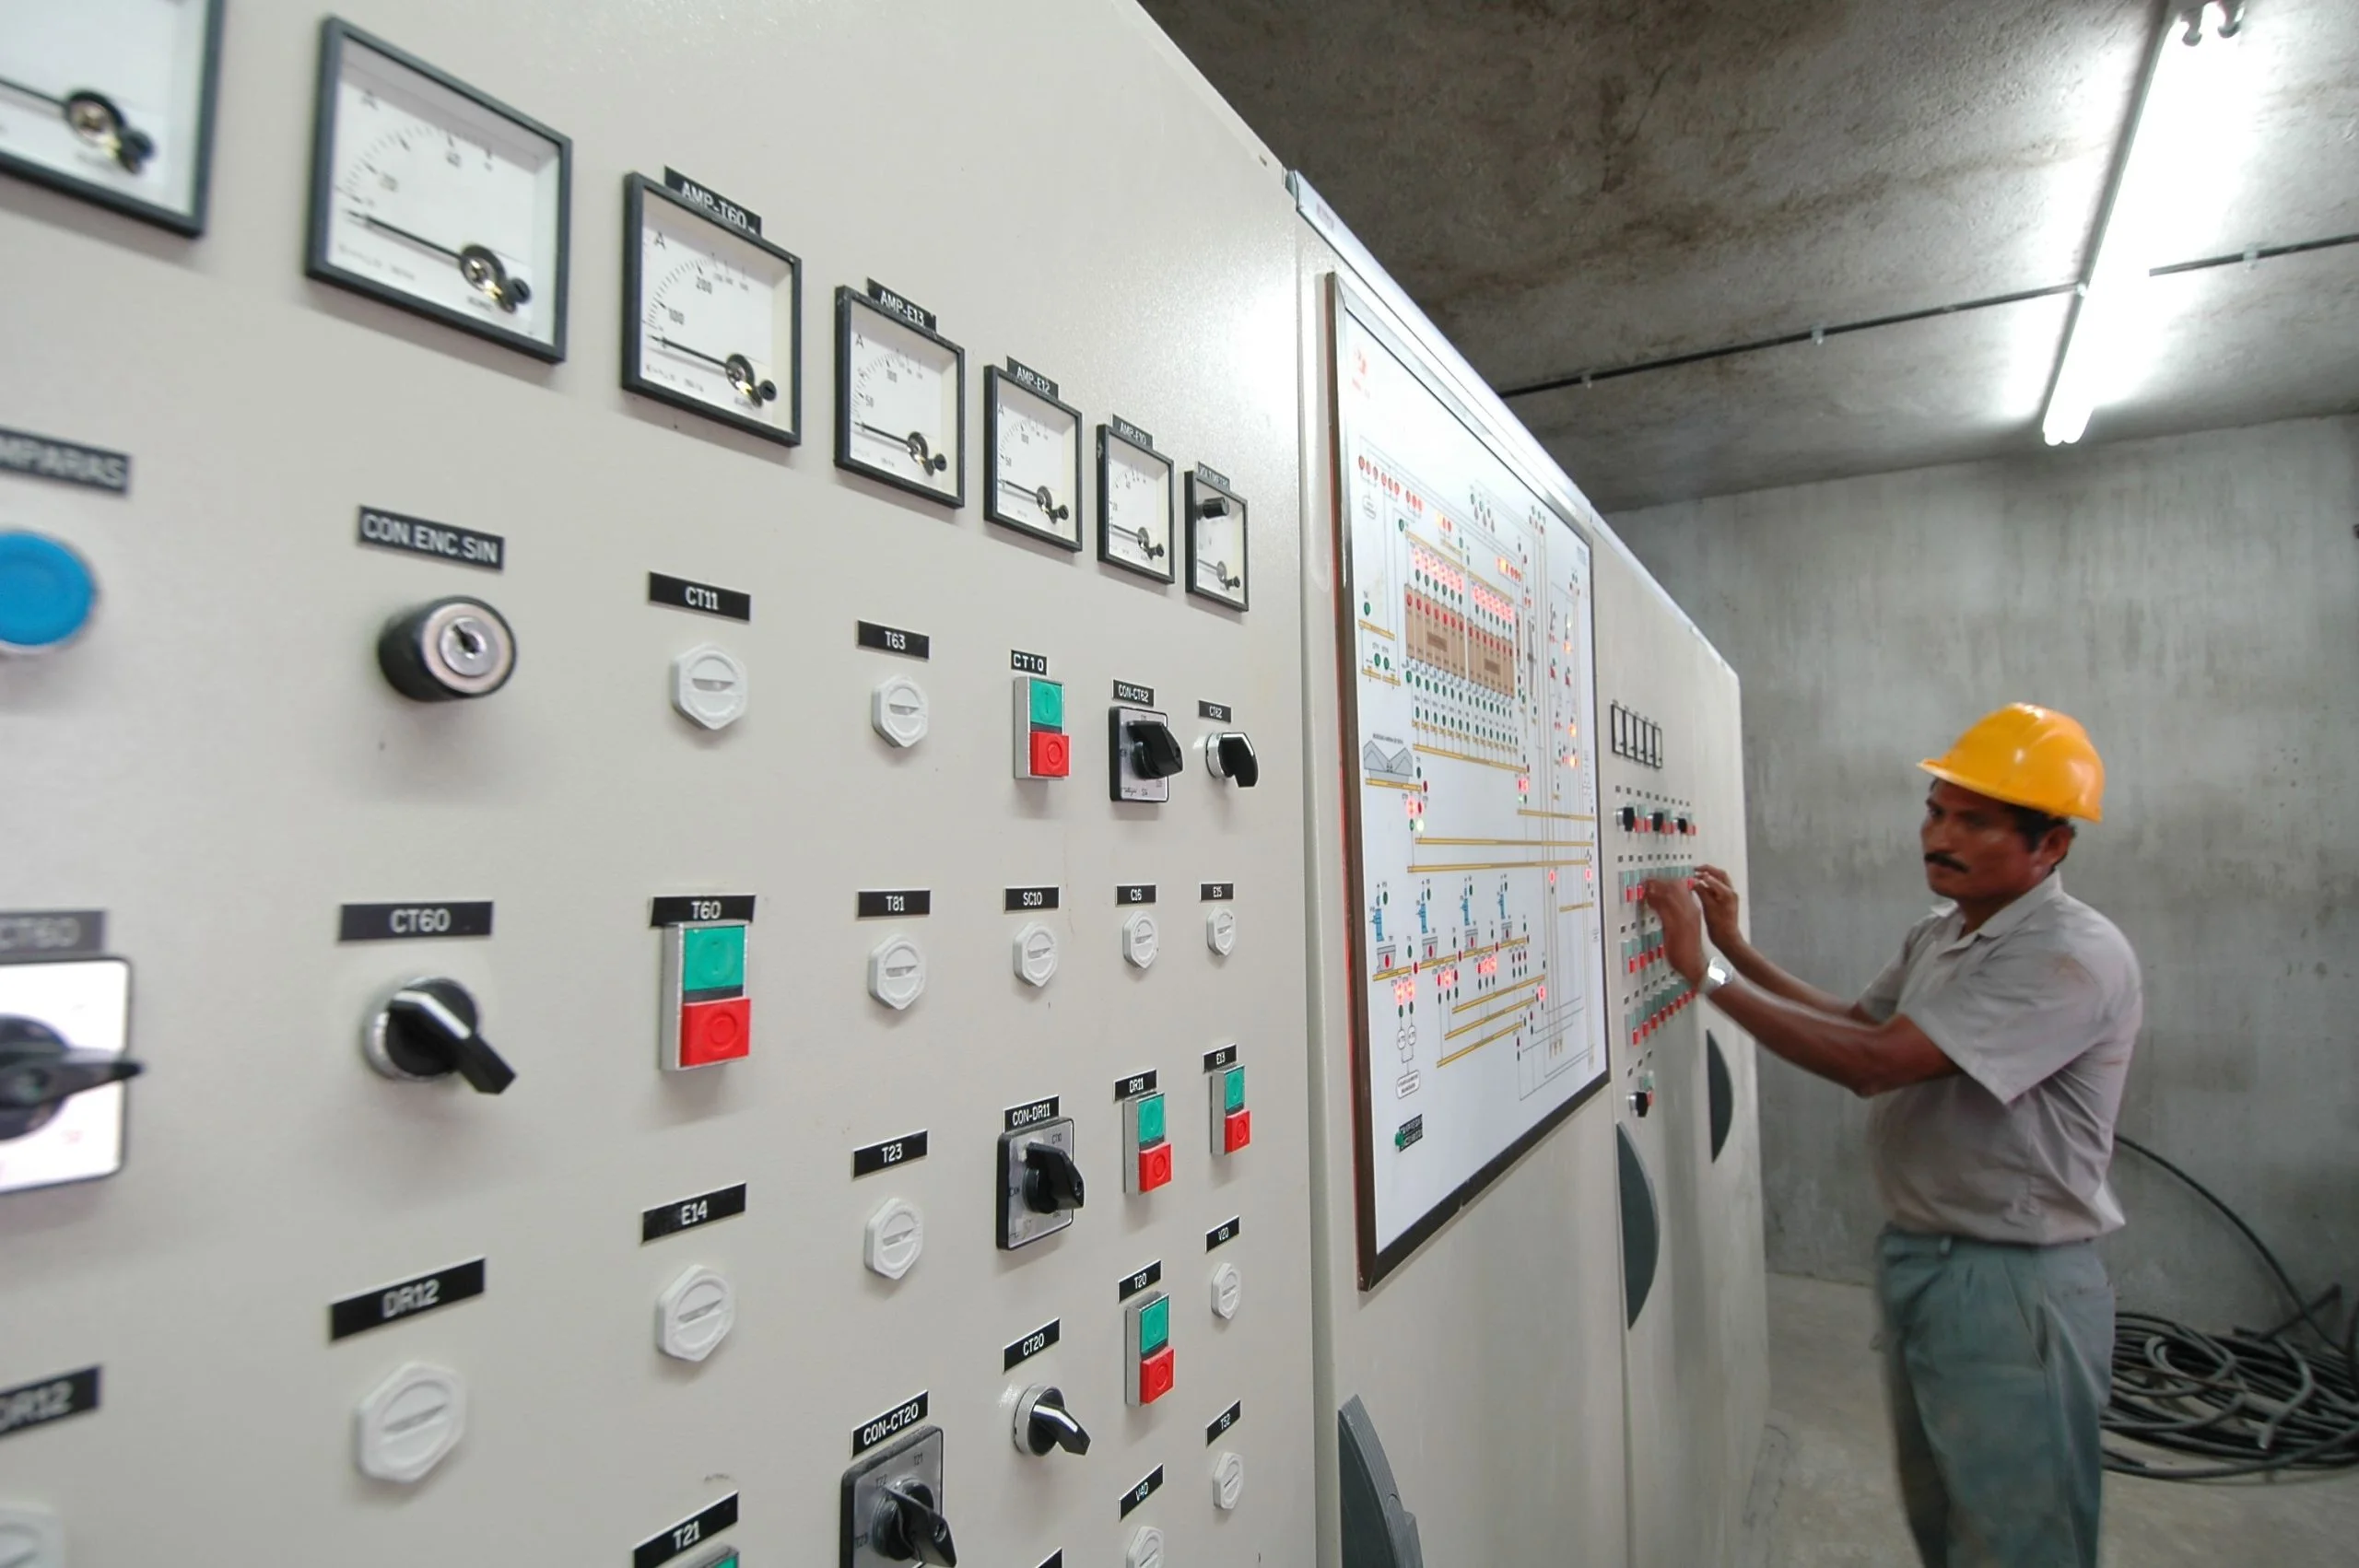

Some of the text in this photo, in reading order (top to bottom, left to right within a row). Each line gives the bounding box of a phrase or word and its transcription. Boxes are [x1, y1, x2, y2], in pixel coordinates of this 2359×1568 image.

[879, 289, 924, 326] AMP-E13
[1016, 366, 1050, 395] AMP-E12
[685, 585, 719, 611] CT11
[885, 629, 906, 650] T63
[1014, 654, 1044, 673] CT10
[1118, 684, 1149, 703] CON-CT62
[691, 899, 722, 920] T60
[886, 895, 905, 913] T81
[1022, 890, 1043, 907] SC10
[389, 907, 452, 934] CT60
[1012, 1103, 1050, 1127] CON-DR11
[881, 1144, 903, 1164] T23
[681, 1200, 708, 1226] E14
[381, 1279, 441, 1319] DR12
[1022, 1332, 1045, 1358] CT20
[863, 1402, 919, 1446] CON-CT20
[674, 1520, 700, 1553] T21
